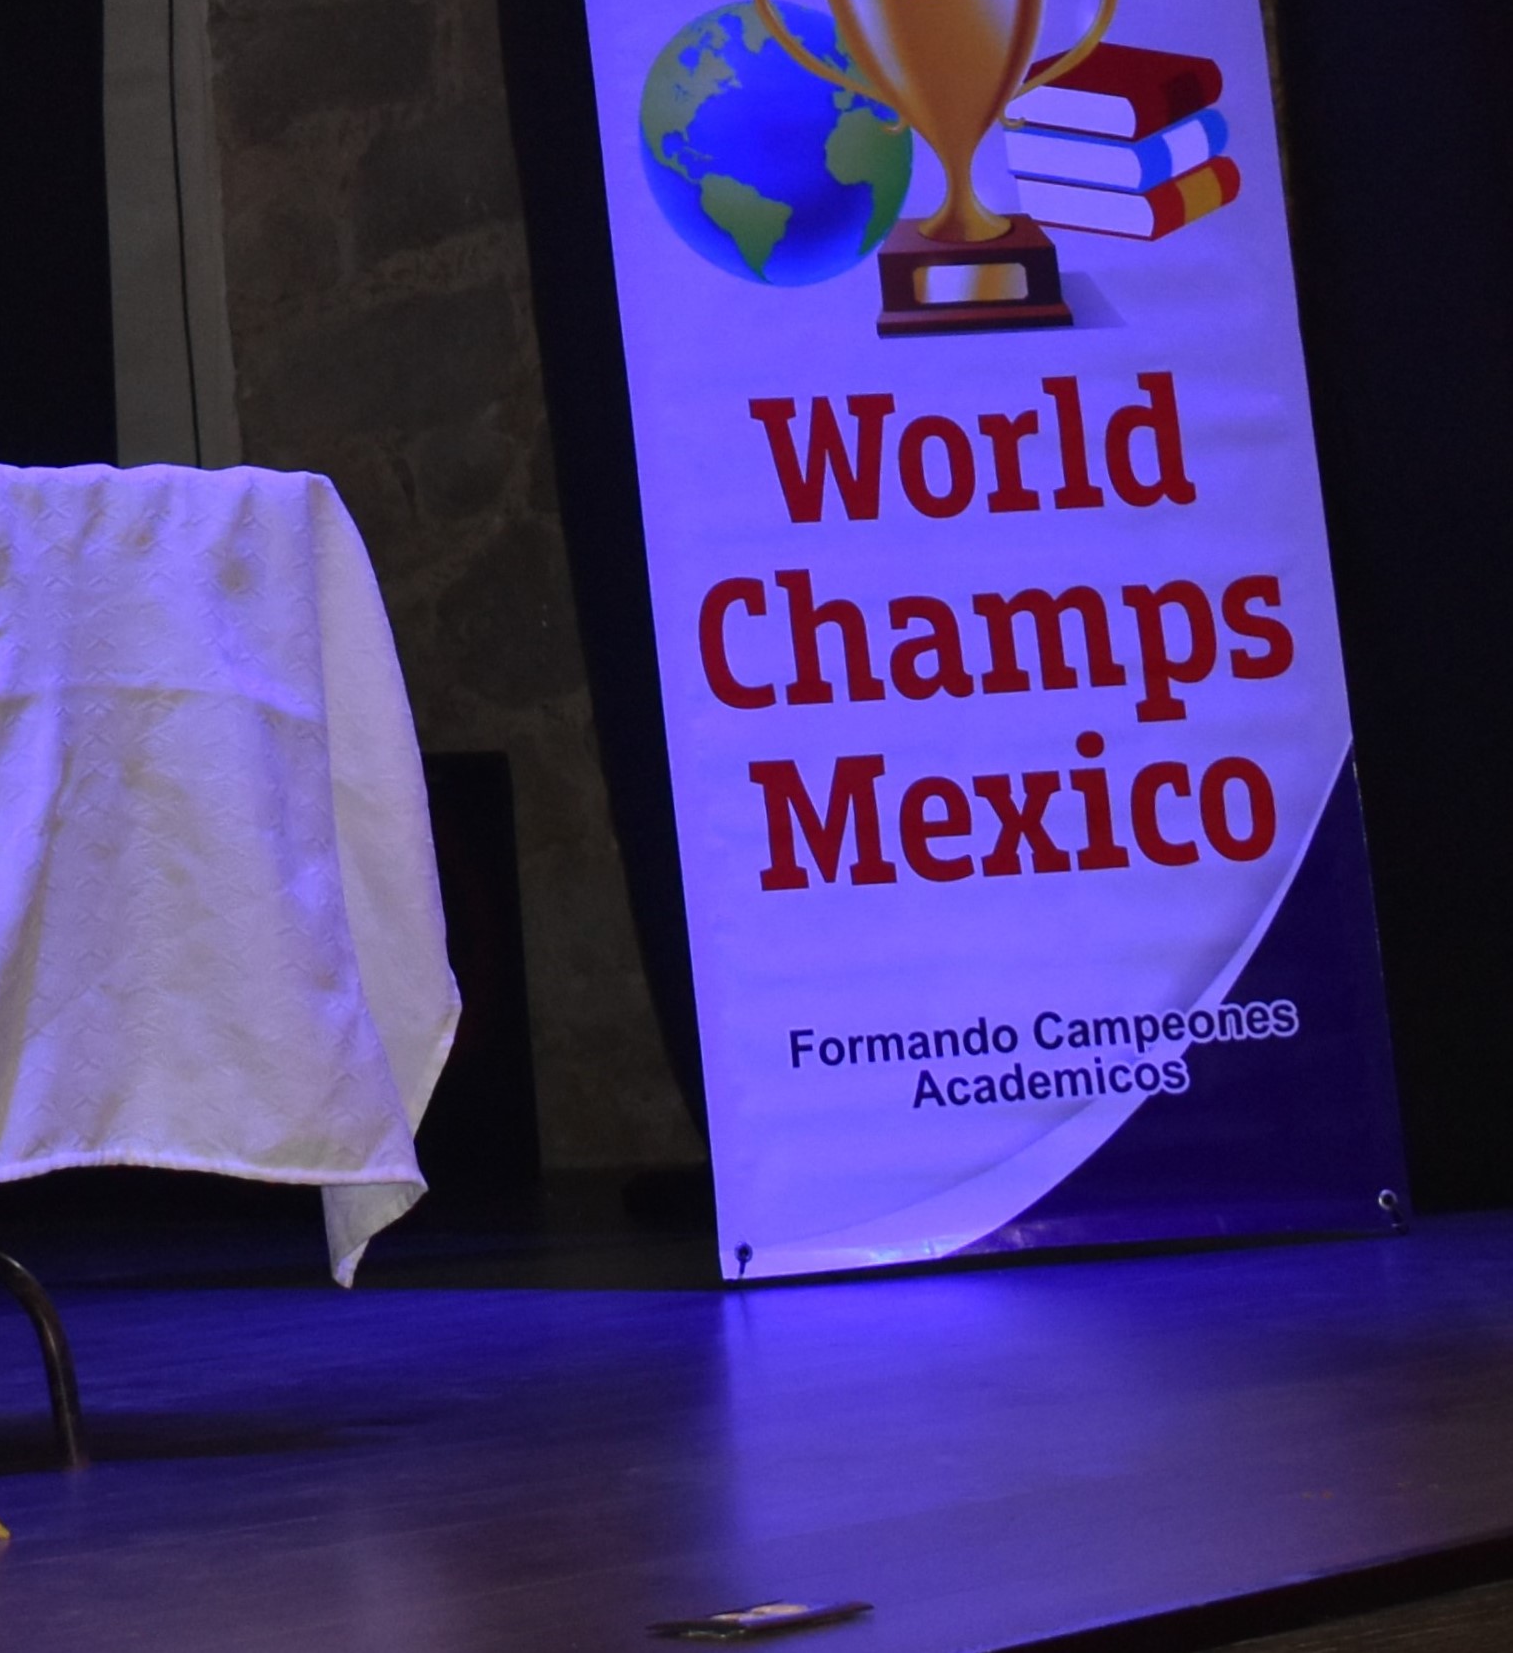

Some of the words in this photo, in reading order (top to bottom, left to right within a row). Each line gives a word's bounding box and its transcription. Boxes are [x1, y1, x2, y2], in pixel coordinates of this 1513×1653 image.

[748, 371, 1197, 524] World
[698, 569, 1294, 724] Champs
[748, 730, 1277, 892] Mexico
[789, 1018, 1019, 1068] Formando
[1032, 1001, 1298, 1055] Campeones
[912, 1056, 1189, 1110] Academicos
